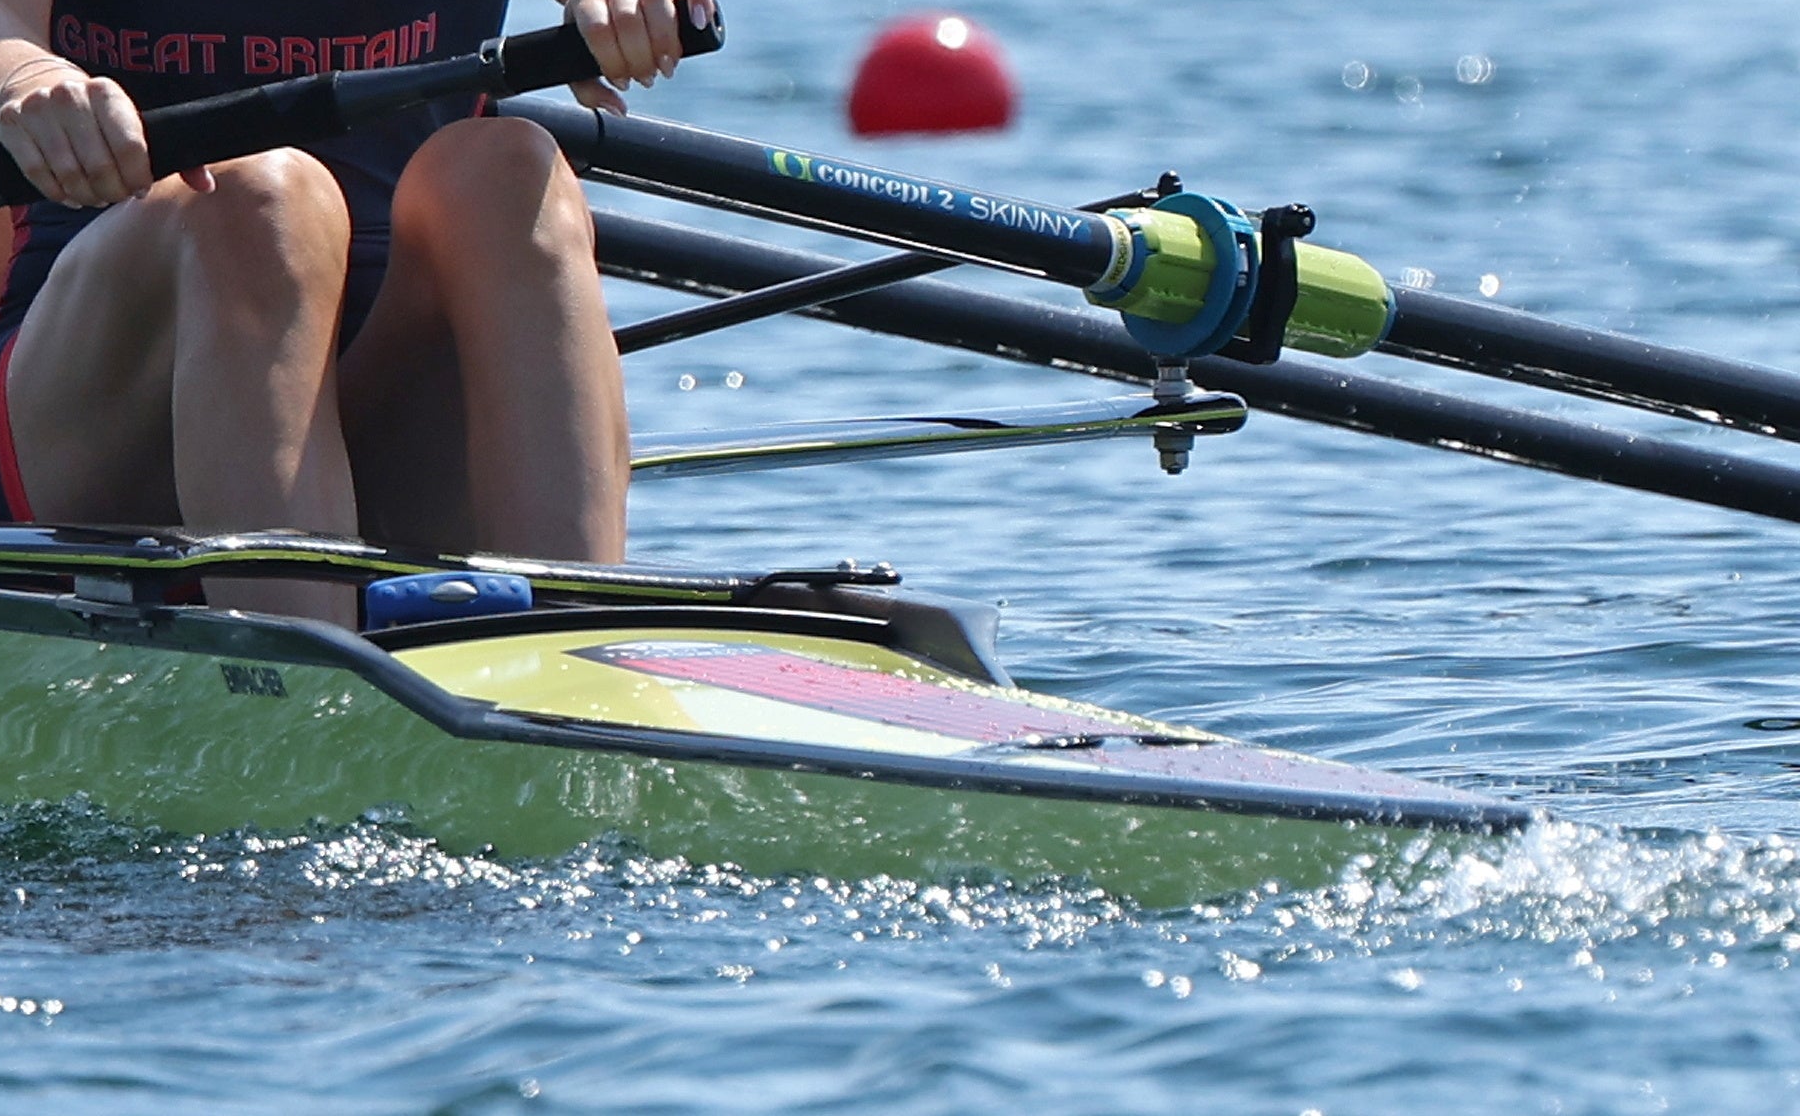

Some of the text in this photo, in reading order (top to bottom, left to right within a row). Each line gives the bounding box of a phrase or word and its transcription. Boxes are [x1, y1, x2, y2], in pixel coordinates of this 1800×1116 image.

[57, 11, 438, 75] GREAT BRITAIN
[817, 163, 1083, 240] concept 2 SKINNY
